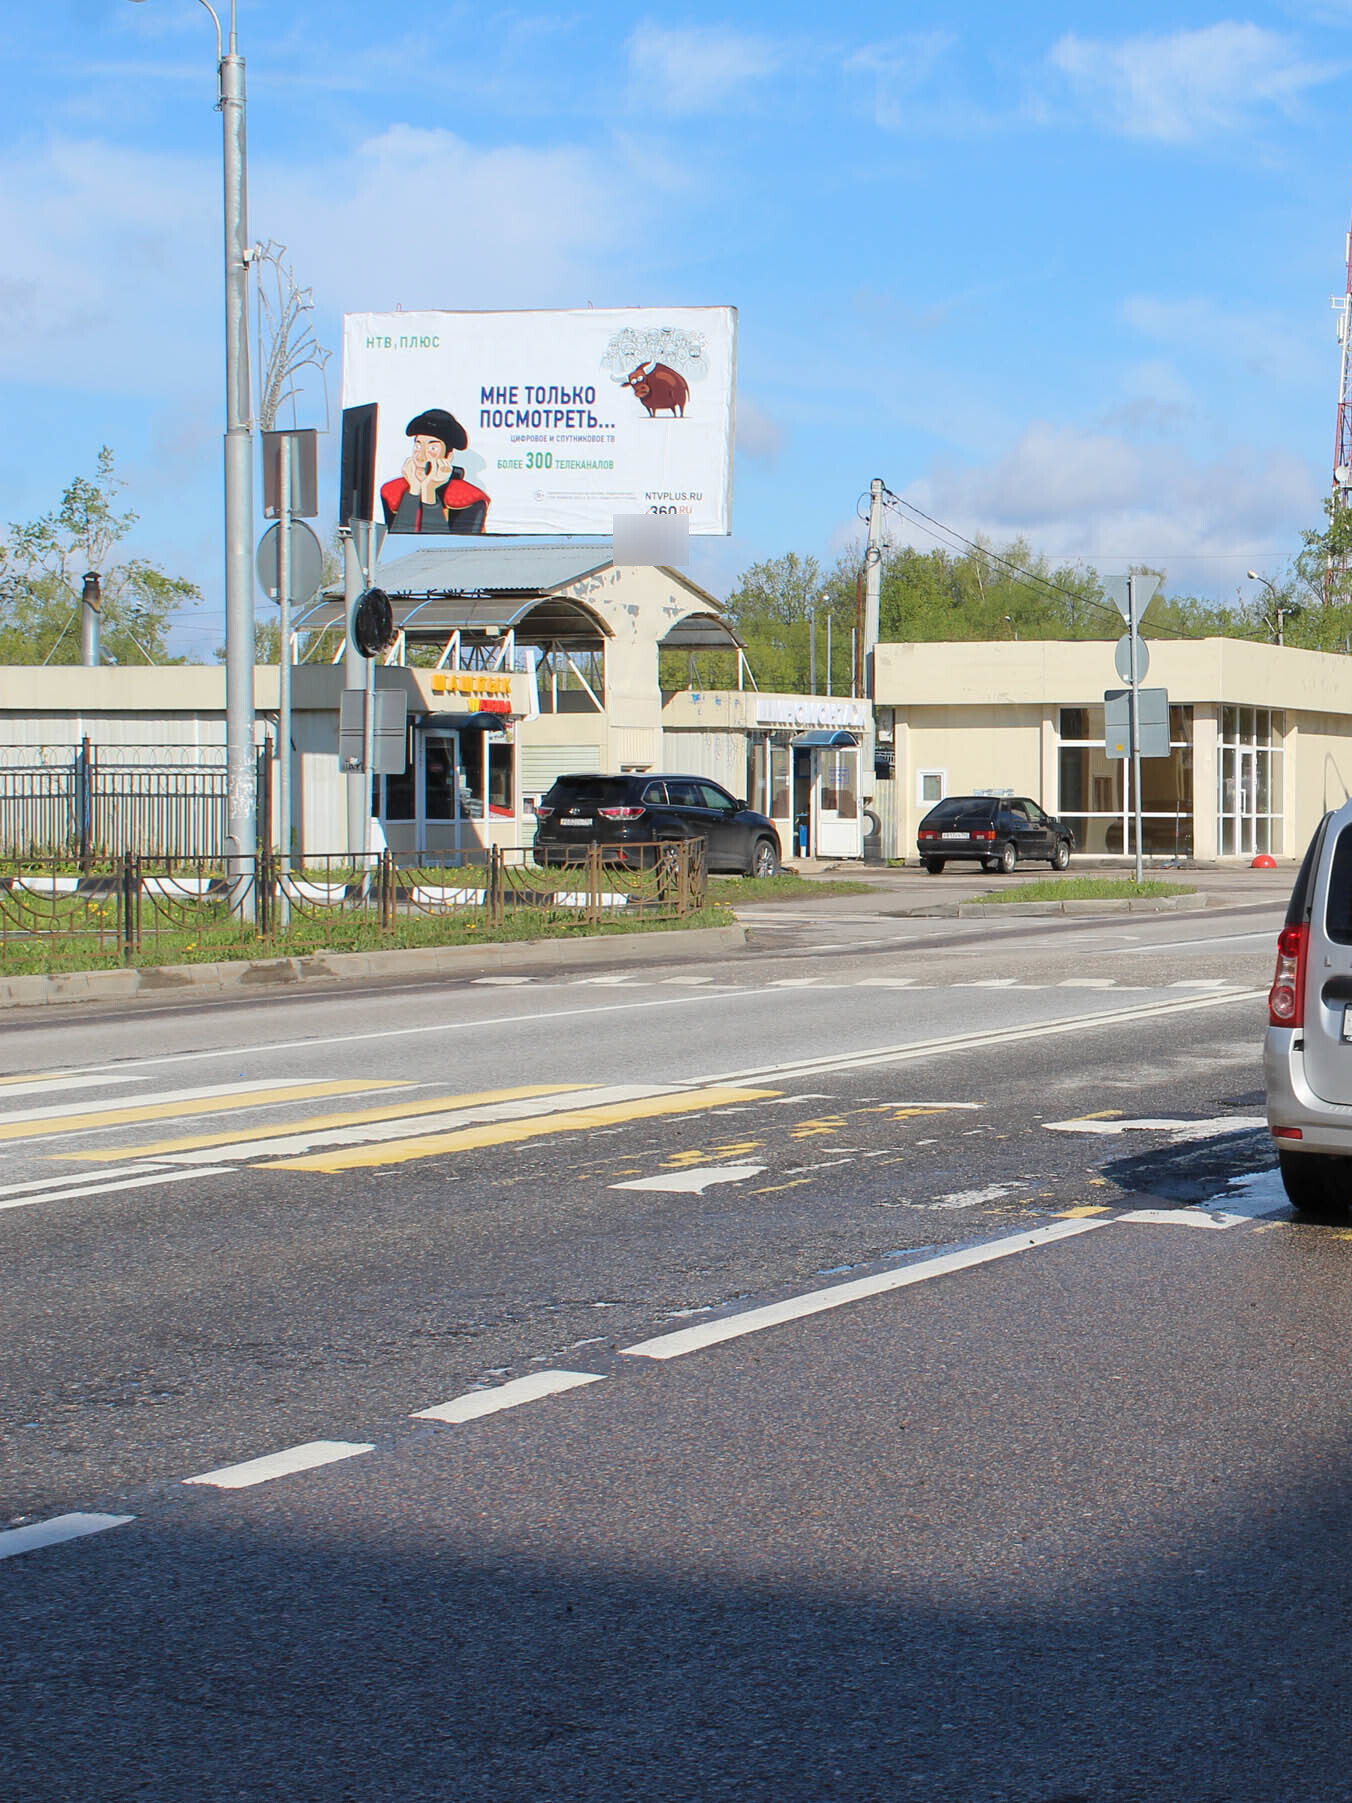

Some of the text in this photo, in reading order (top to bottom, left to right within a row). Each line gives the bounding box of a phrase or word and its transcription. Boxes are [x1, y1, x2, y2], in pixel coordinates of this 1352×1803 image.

[480, 386, 597, 405] МНЕ ТОЛЬКО
[480, 409, 616, 428] ПОСМОТРЕТЬ...
[510, 435, 615, 443] ЦИФРОВОЕ И СПУТНИКОВОЕ ТВ
[497, 452, 614, 470] БОЛЕЕ 300 ТЕЛЕКАНАЛОВ
[645, 492, 703, 501] NTVPLUS.RU
